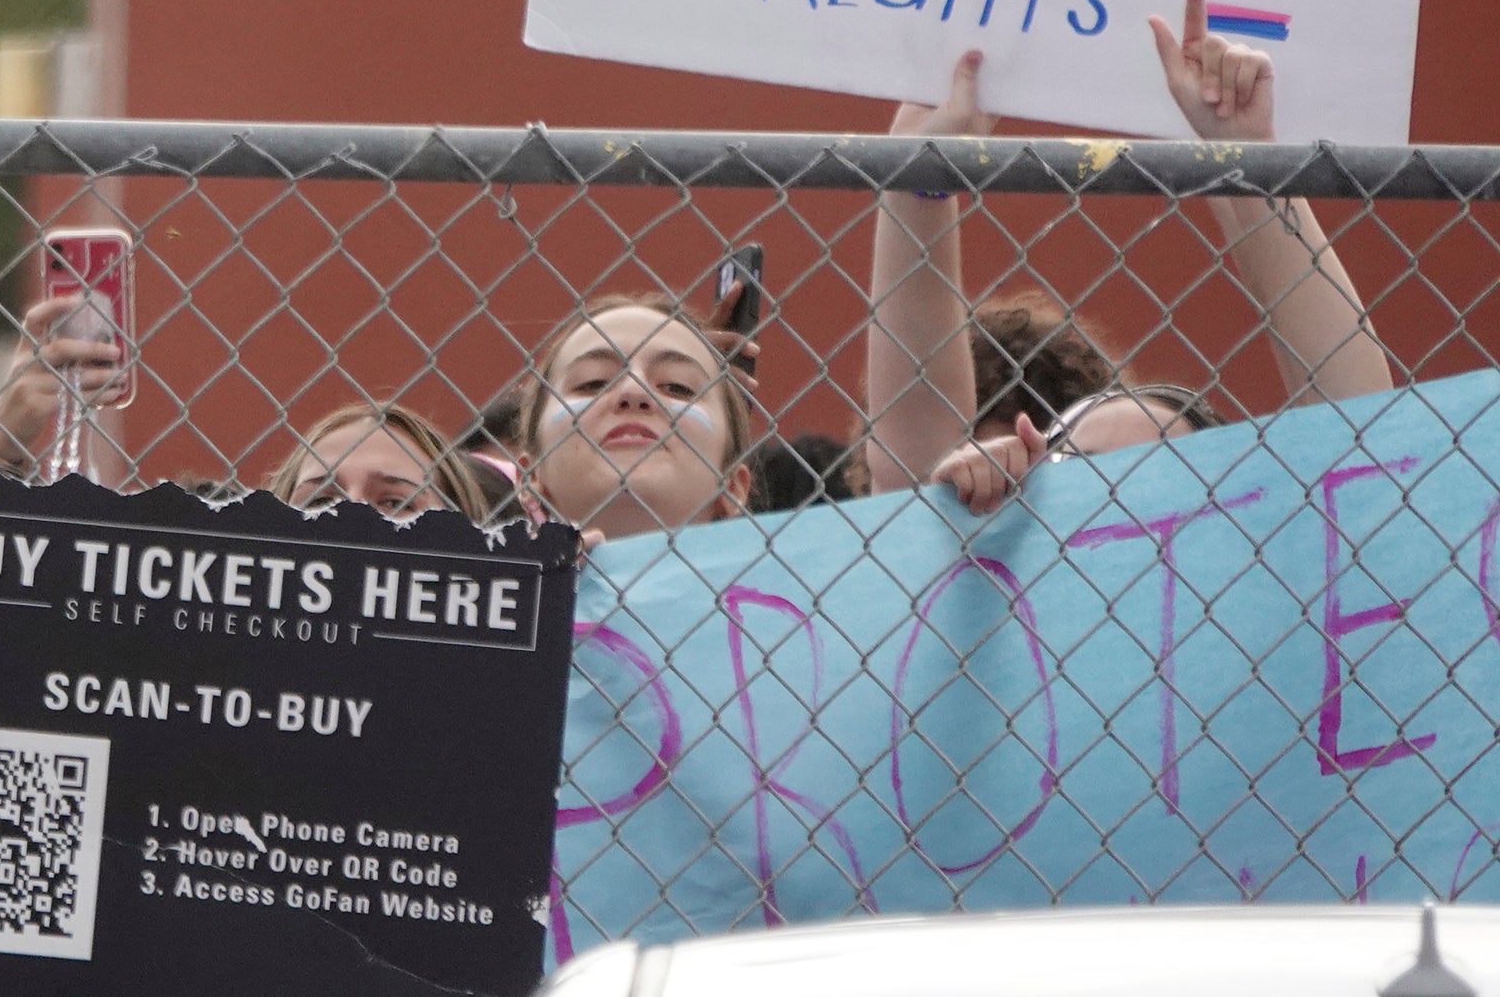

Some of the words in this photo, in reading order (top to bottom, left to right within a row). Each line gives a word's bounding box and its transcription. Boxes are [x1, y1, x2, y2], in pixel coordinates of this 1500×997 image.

[74, 542, 334, 614] TICKETS
[363, 567, 520, 632] HERE
[64, 599, 150, 627] SELF
[173, 608, 363, 647] CHECKOUT
[42, 672, 373, 738] SCAN-TO-BUY
[548, 456, 1500, 967] PROTE
[148, 803, 170, 829] 1.
[260, 811, 347, 845] Phone
[356, 822, 460, 854] Camera
[142, 837, 167, 863] 2.
[179, 840, 259, 871] Hover
[269, 848, 334, 877] Over
[342, 855, 381, 882] QR
[390, 859, 459, 889] Code
[139, 869, 165, 896] 3.
[174, 873, 276, 907] Access
[285, 883, 371, 915] GoFan
[381, 891, 495, 926] Website
